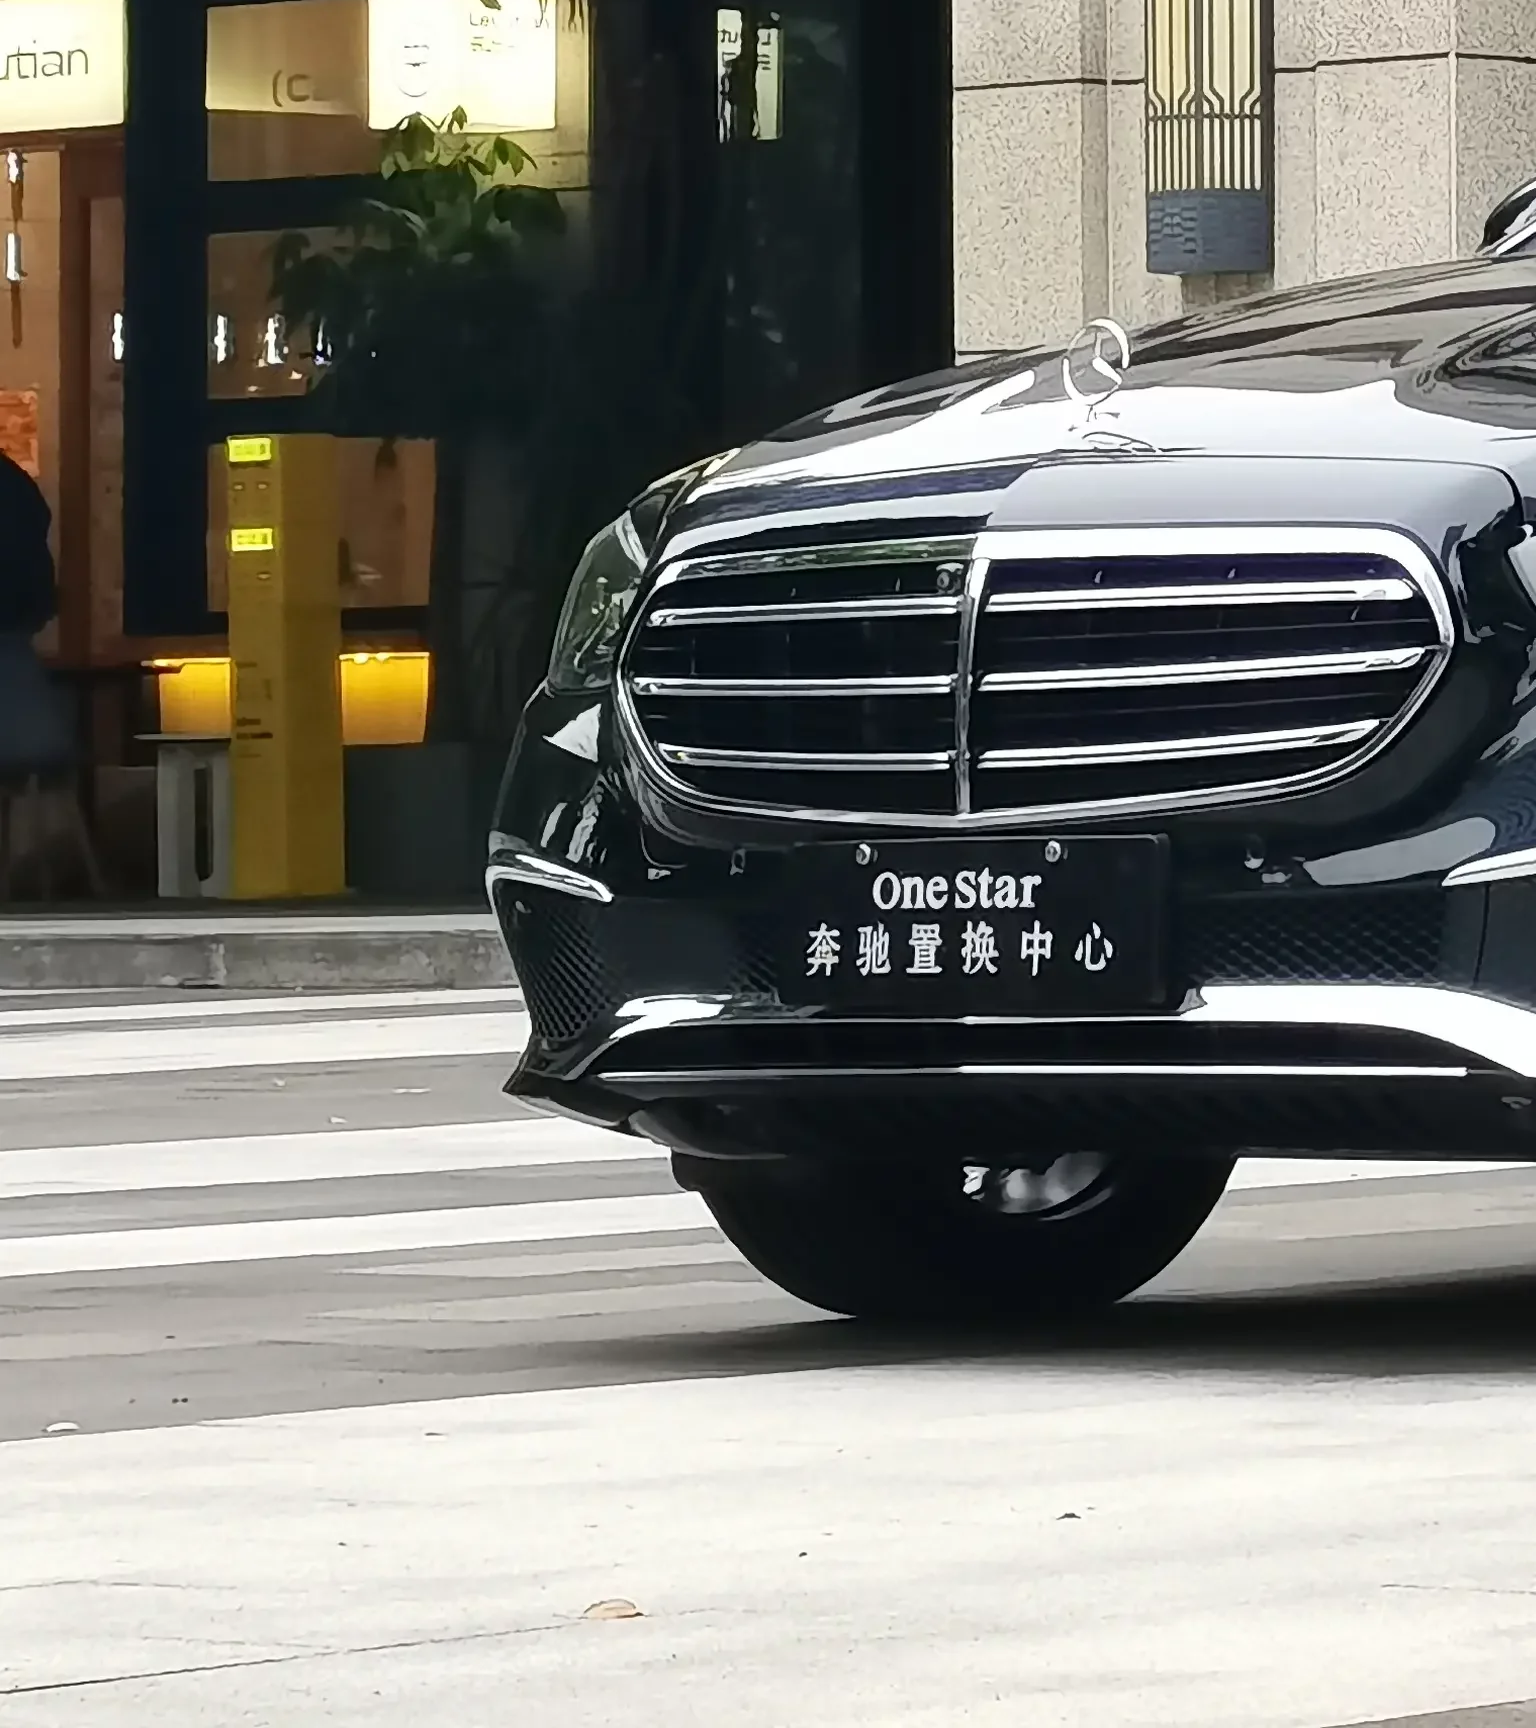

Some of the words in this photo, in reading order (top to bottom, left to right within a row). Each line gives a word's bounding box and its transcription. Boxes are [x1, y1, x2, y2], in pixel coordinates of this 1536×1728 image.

[805, 919, 1115, 977] 奔驰置换中心
